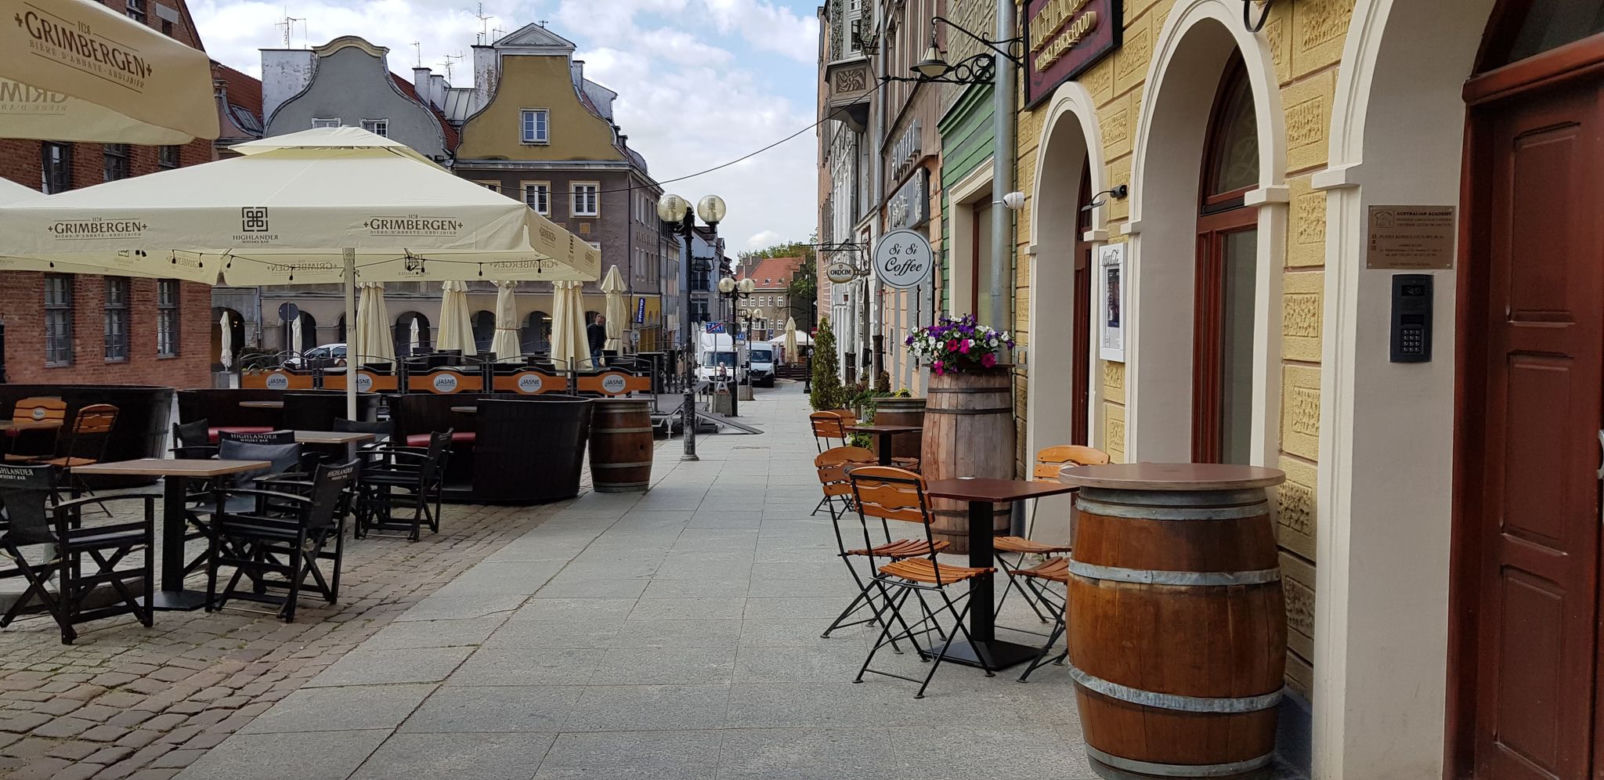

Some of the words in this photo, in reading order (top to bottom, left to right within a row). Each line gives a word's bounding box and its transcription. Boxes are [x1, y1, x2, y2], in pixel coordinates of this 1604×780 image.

[77, 21, 91, 35] 1128
[1072, 11, 1097, 38] FOOD
[24, 11, 146, 78] GRIMBERGEN
[54, 222, 142, 234] GRIMBERGEN
[370, 218, 457, 231] GRIMBERGEN
[889, 242, 902, 255] Si
[905, 242, 919, 255] Si
[884, 257, 923, 276] Coffee
